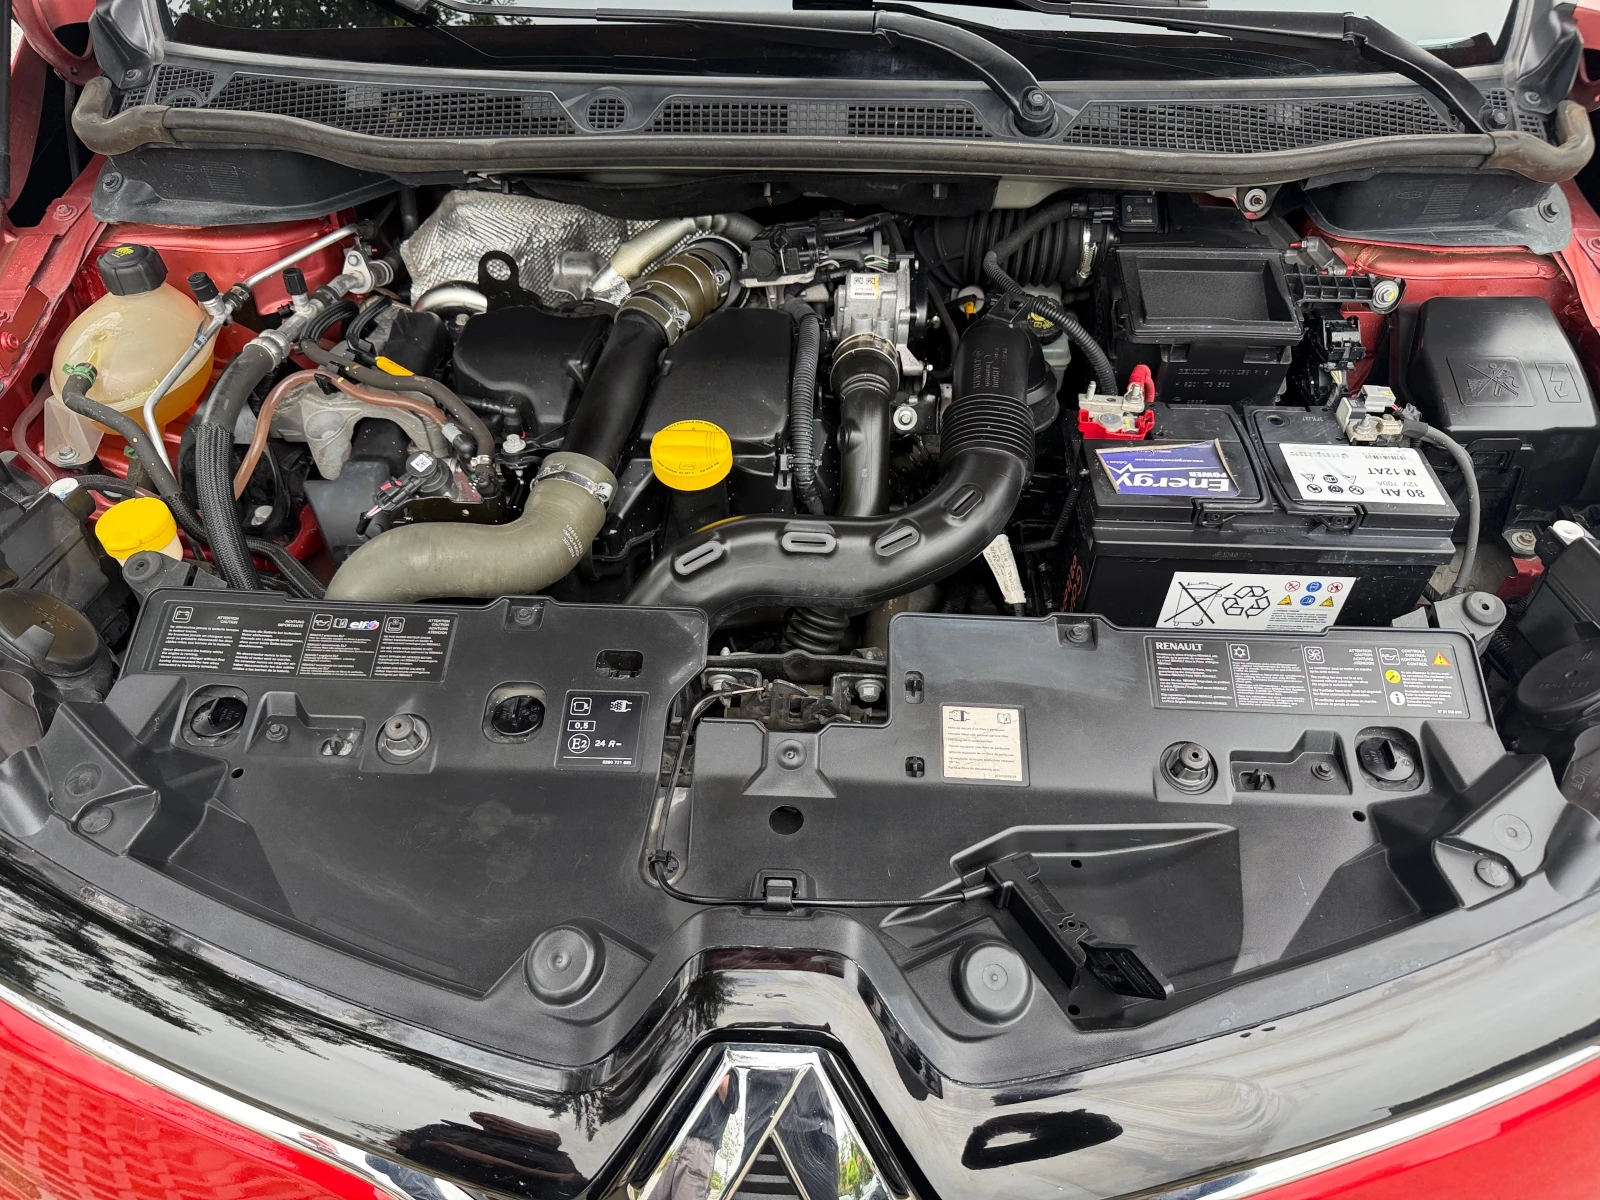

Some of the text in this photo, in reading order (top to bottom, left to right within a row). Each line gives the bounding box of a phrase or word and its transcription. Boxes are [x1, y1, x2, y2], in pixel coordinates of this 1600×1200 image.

[1367, 467, 1416, 476] M 12AT
[1115, 473, 1230, 492] Energy
[1380, 488, 1425, 498] 80 Ah
[349, 620, 369, 629] elf
[1156, 642, 1203, 651] RENAULT
[574, 722, 589, 730] 0,5
[571, 738, 588, 749] E2
